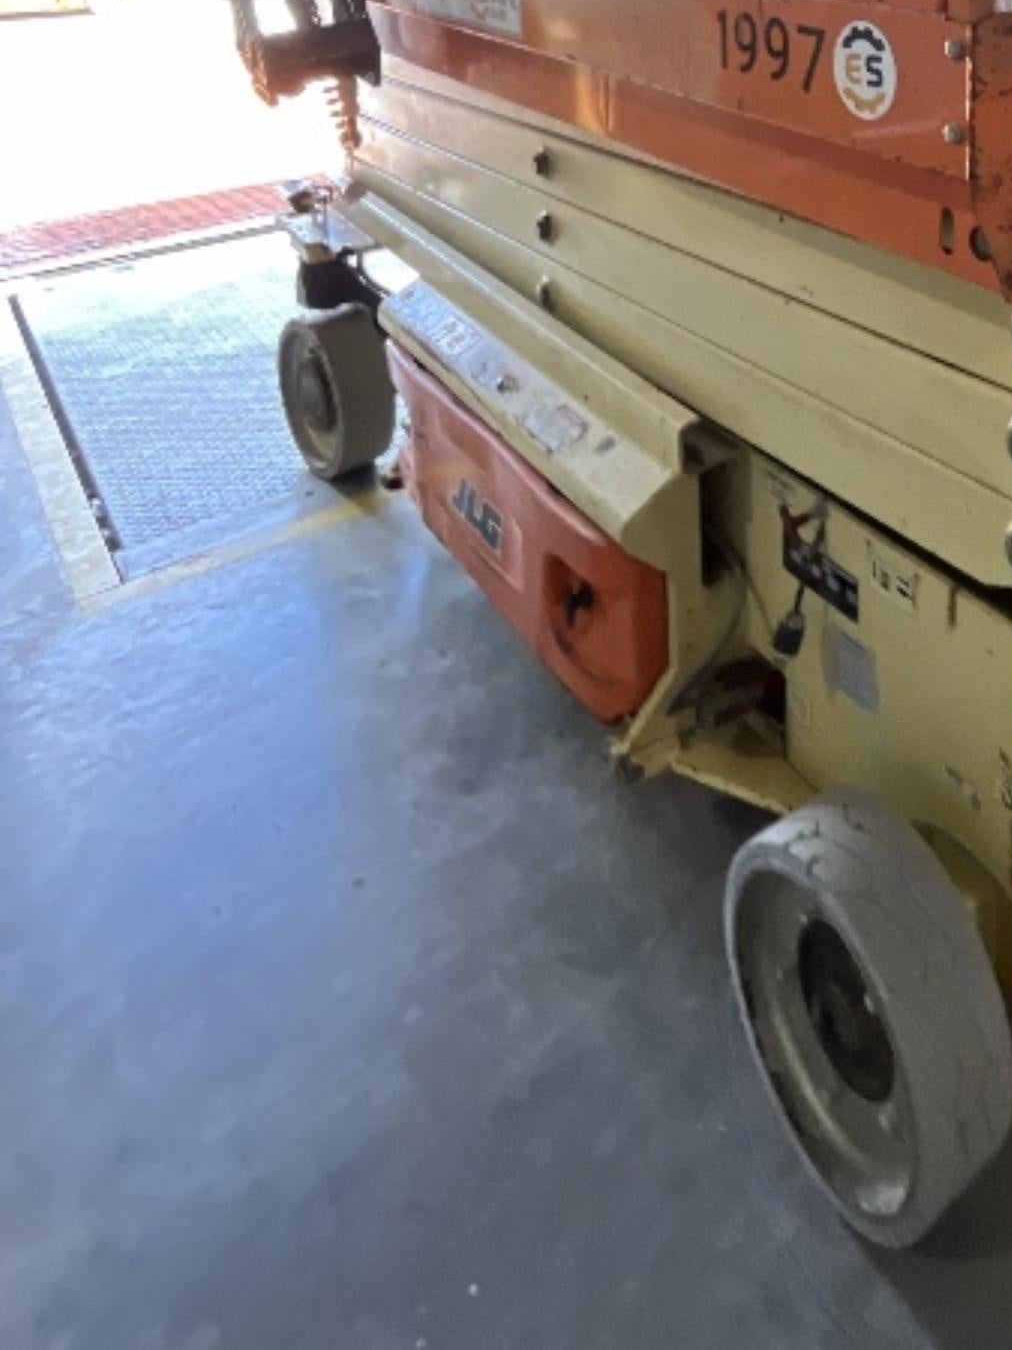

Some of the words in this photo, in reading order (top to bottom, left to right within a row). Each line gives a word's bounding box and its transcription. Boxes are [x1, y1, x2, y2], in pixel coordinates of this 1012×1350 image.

[716, 9, 826, 94] 1997
[845, 53, 883, 88] ES
[452, 477, 502, 549] JLG
